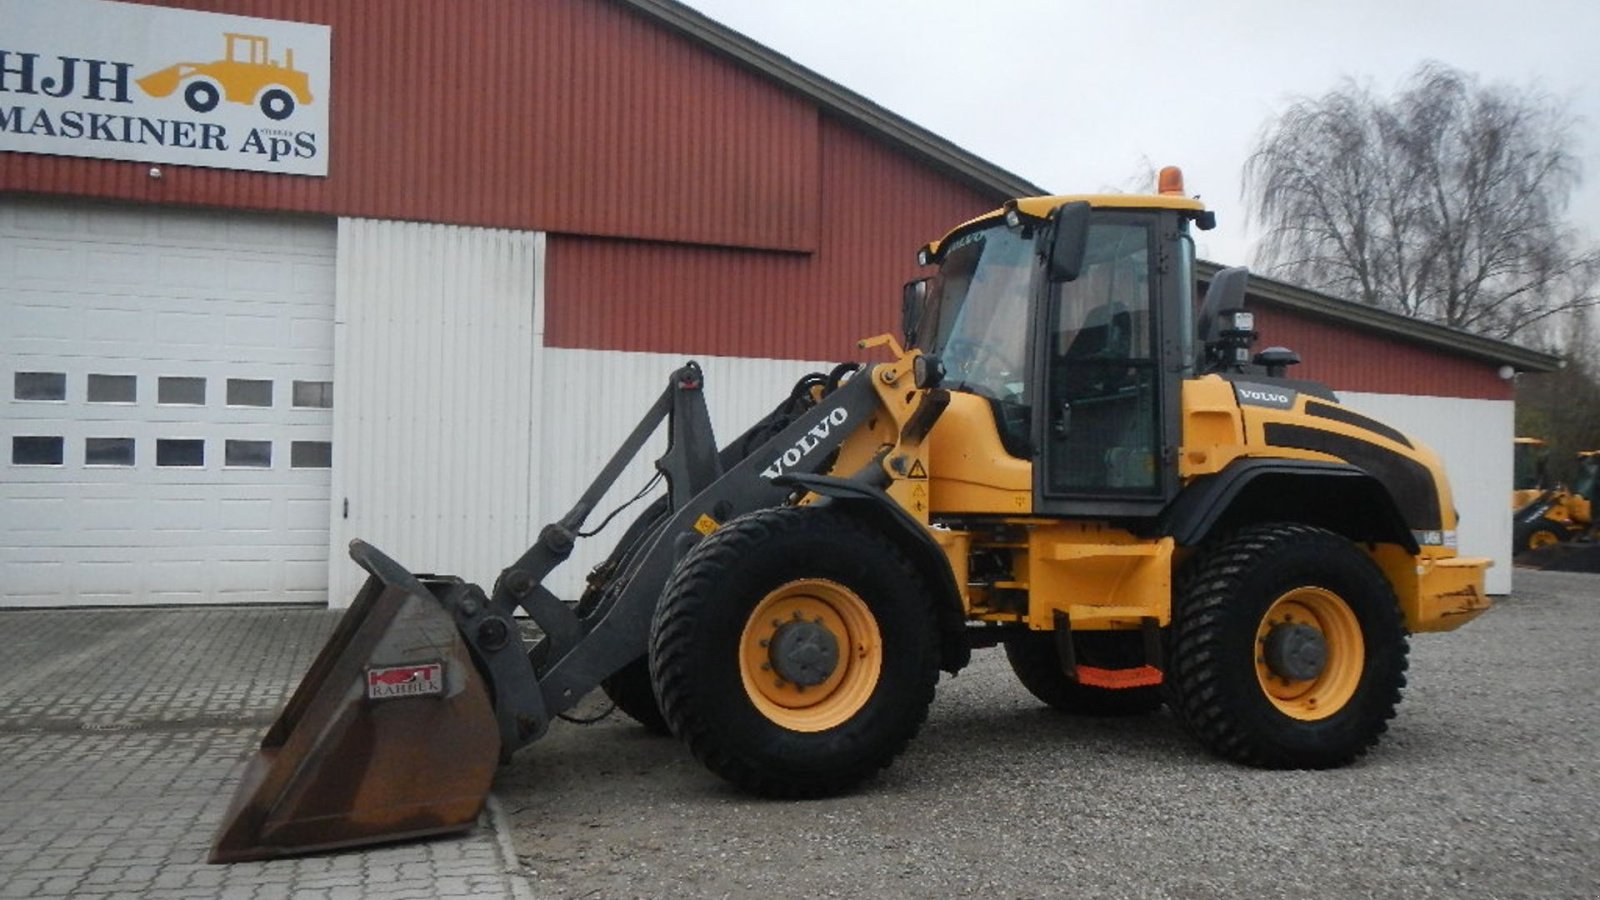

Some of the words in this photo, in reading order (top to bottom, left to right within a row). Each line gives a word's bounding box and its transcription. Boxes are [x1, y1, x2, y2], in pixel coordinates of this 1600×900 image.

[0, 51, 133, 103] HJH
[0, 106, 228, 151] MASKINER
[239, 128, 317, 161] ApS
[1239, 389, 1289, 403] VOLVO
[760, 407, 848, 479] VOLVO
